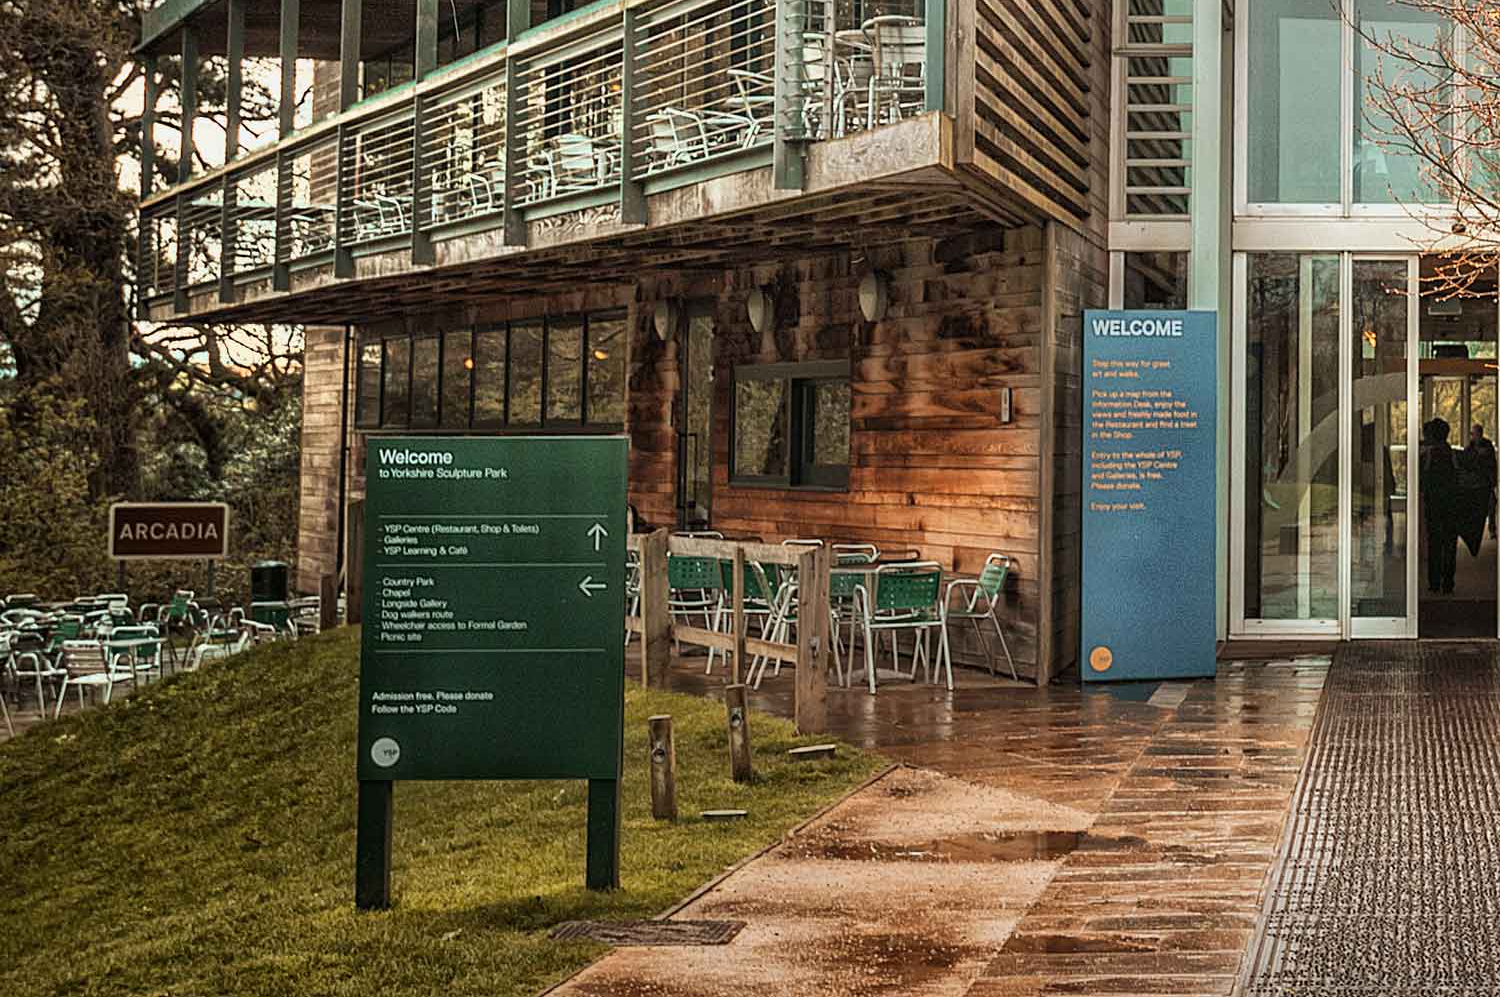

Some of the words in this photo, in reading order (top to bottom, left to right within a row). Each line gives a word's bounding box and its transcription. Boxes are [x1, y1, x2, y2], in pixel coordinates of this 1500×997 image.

[1092, 319, 1183, 336] WELCOME
[379, 448, 454, 465] Welcome
[380, 468, 390, 478] to
[391, 467, 434, 478] Yorkshire
[436, 467, 482, 480] Sculpture
[484, 467, 508, 478] Park
[120, 522, 219, 540] ARCADIA
[384, 523, 402, 533] YSP
[403, 523, 430, 533] Centre
[480, 523, 502, 535] Shop
[502, 524, 511, 533] &
[384, 534, 418, 544] Galleries
[384, 545, 402, 555] YSP
[403, 545, 438, 557] Learning
[439, 546, 447, 555] &
[382, 576, 415, 587] Country
[416, 576, 434, 586] Park
[382, 588, 411, 599] Chapel
[382, 599, 418, 610] Longside
[419, 599, 448, 609] Gallery
[381, 610, 399, 621] Dog
[400, 609, 431, 619] walkers
[432, 610, 454, 619] route
[382, 620, 426, 630] Wheelchair
[427, 622, 456, 630] access
[457, 621, 467, 630] to
[468, 620, 496, 630] Formal
[497, 620, 528, 630] Garden
[380, 632, 406, 642] Picnic
[407, 632, 423, 642] site
[372, 691, 415, 701] Admission
[436, 691, 464, 701] Please
[464, 691, 494, 701] donate
[371, 704, 399, 714] Follow
[400, 704, 415, 714] the
[415, 703, 434, 714] YSP
[434, 704, 457, 714] Code
